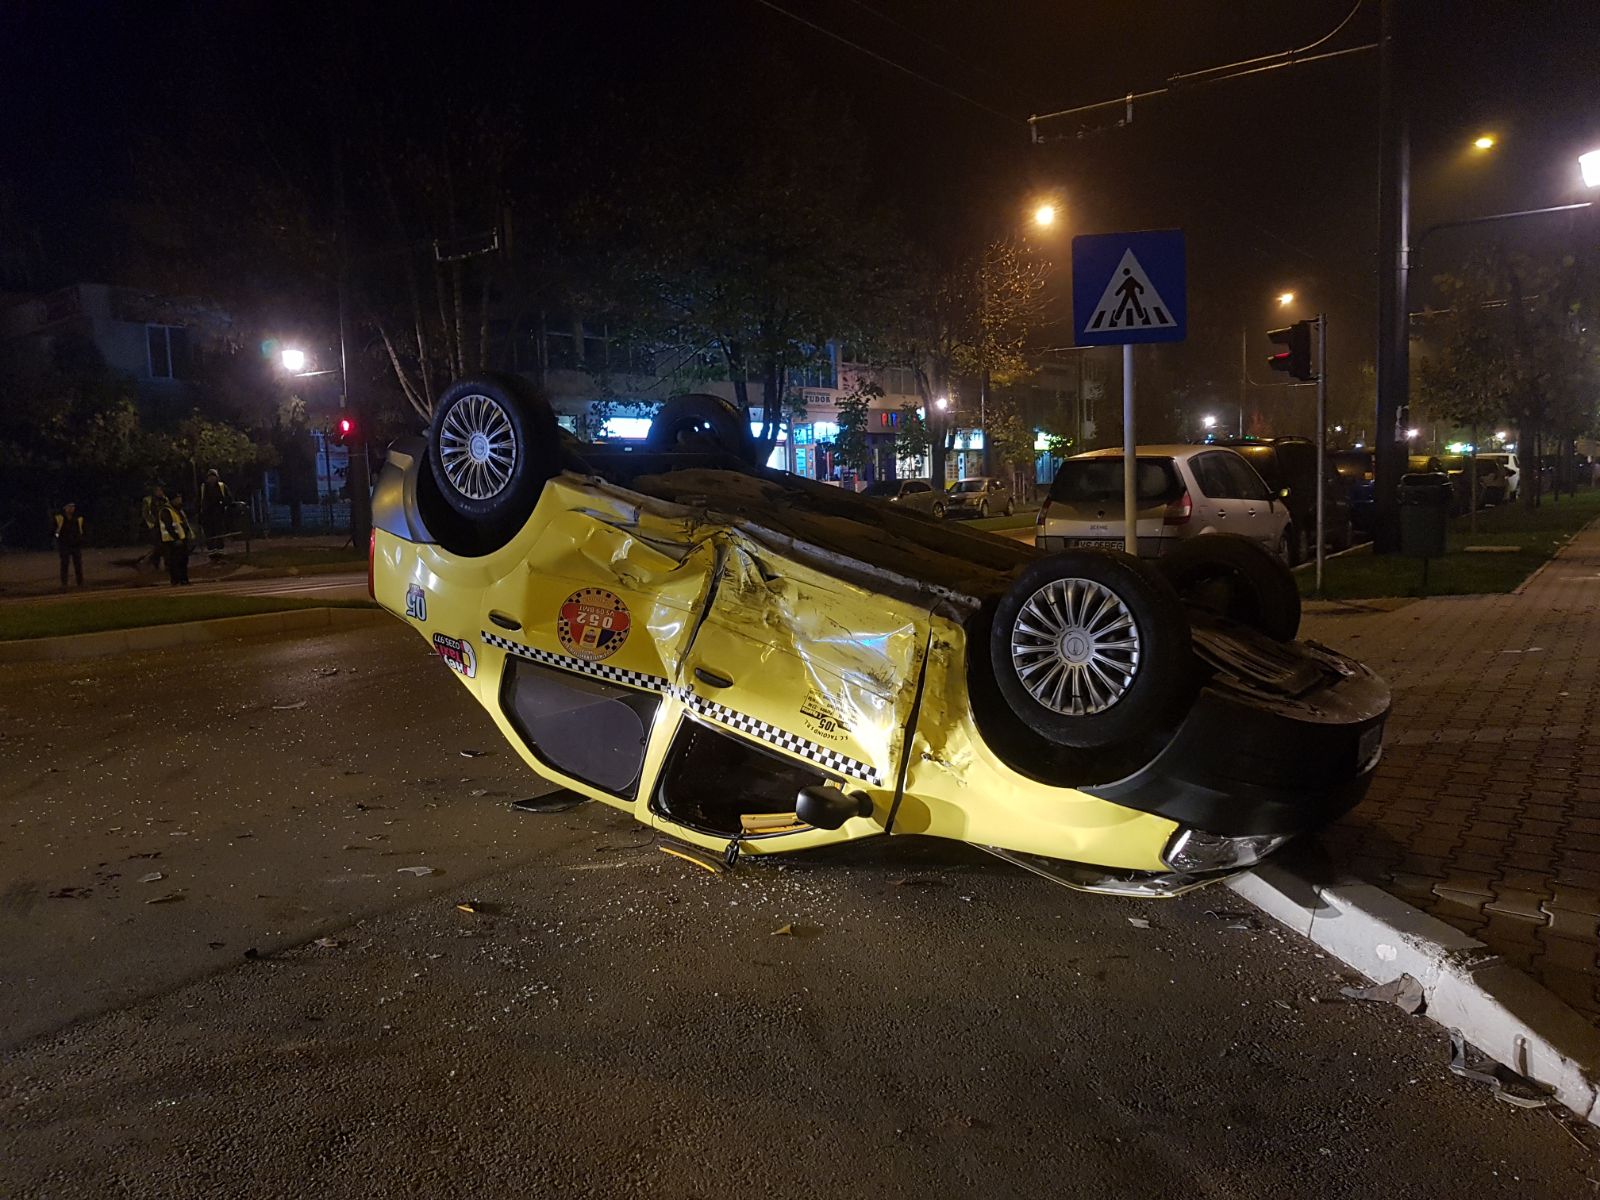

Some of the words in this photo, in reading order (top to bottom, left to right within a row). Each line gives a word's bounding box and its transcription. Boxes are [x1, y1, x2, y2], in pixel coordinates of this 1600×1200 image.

[406, 592, 427, 621] 05
[577, 611, 613, 629] 052
[818, 718, 836, 733] 105
